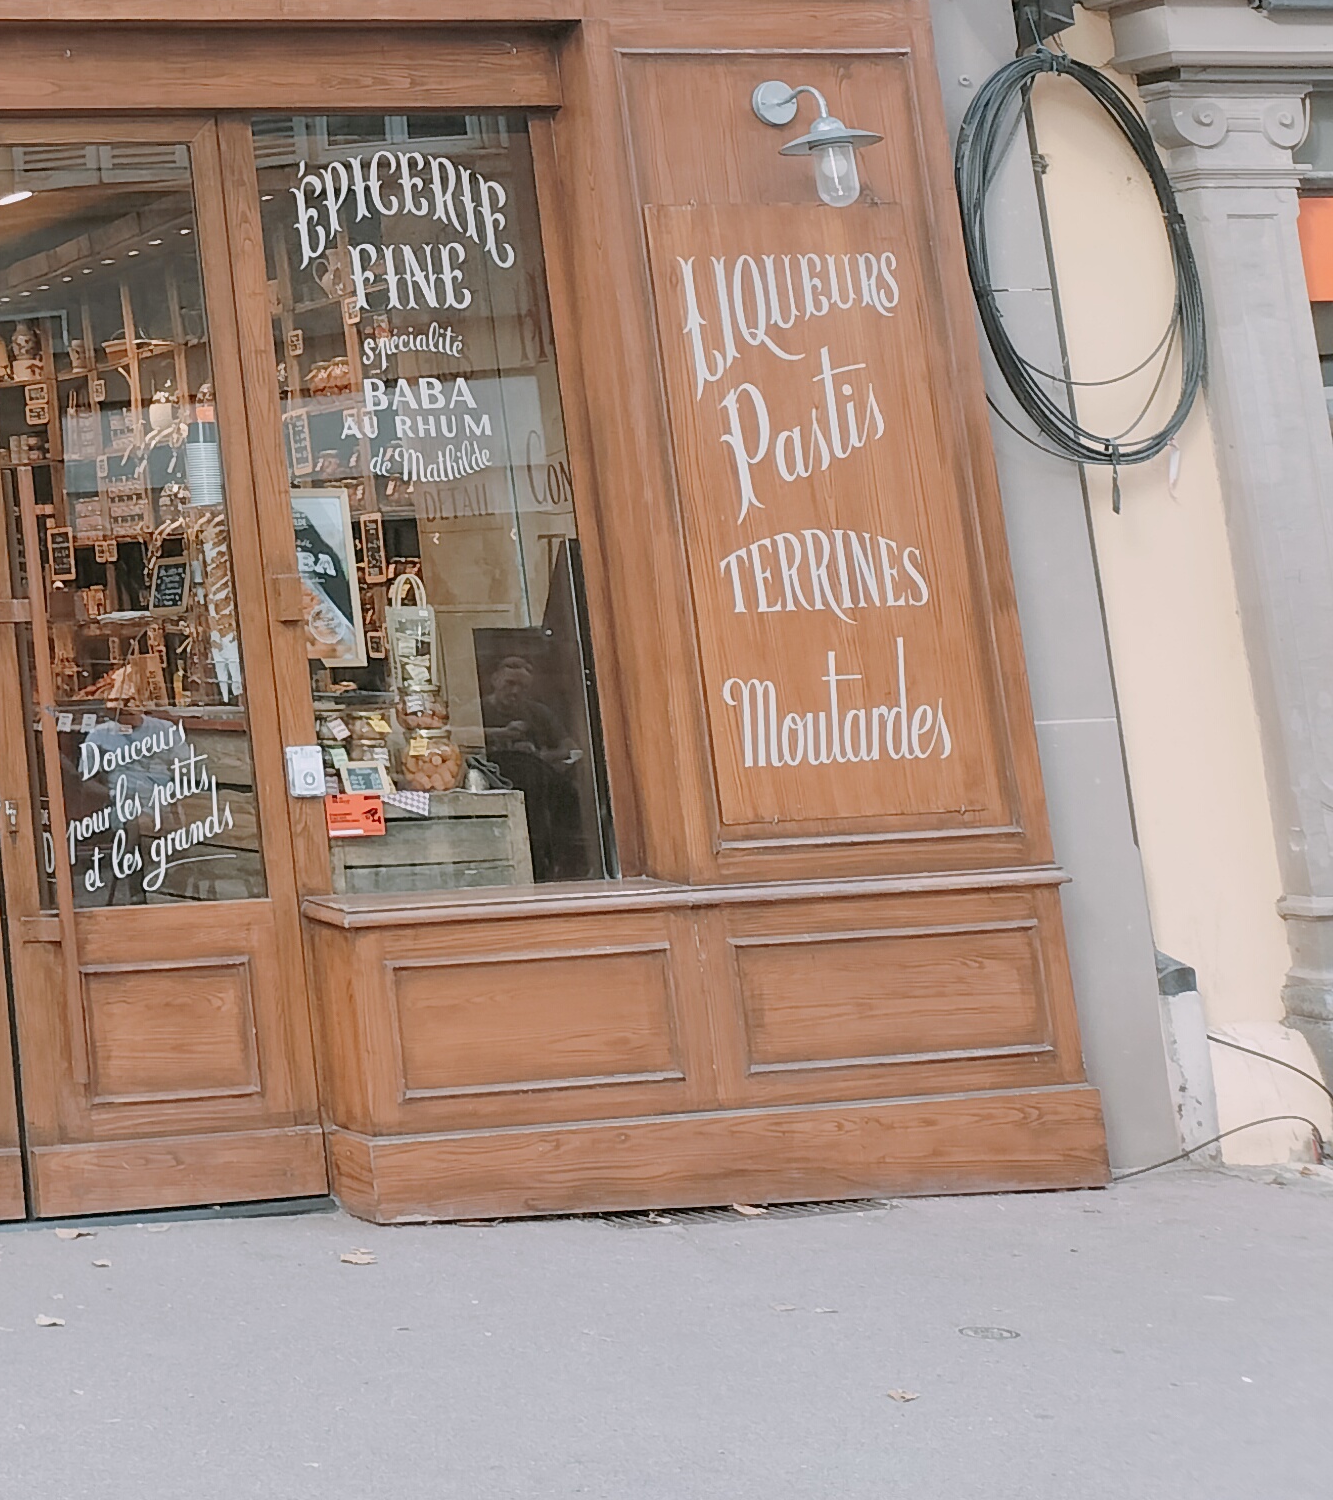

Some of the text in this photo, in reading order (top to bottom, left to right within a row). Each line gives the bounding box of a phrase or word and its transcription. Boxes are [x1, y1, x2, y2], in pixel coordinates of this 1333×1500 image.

[289, 150, 515, 270] ÉPICERIE
[347, 242, 472, 310] FINE
[362, 322, 464, 372] spécialité
[676, 251, 900, 401] LIQUEURS
[340, 414, 493, 440] AU RHUM
[363, 377, 477, 411] BABA
[719, 346, 886, 525] Pastis
[370, 440, 493, 483] de Mathilde
[720, 529, 929, 625] TERRINES
[79, 719, 186, 781] Douceurs
[723, 637, 952, 768] Moutardes
[66, 806, 112, 865] pour
[115, 774, 142, 823] les
[148, 744, 209, 832] petits
[85, 847, 105, 892] et
[112, 829, 142, 879] les
[142, 774, 235, 891] grands
